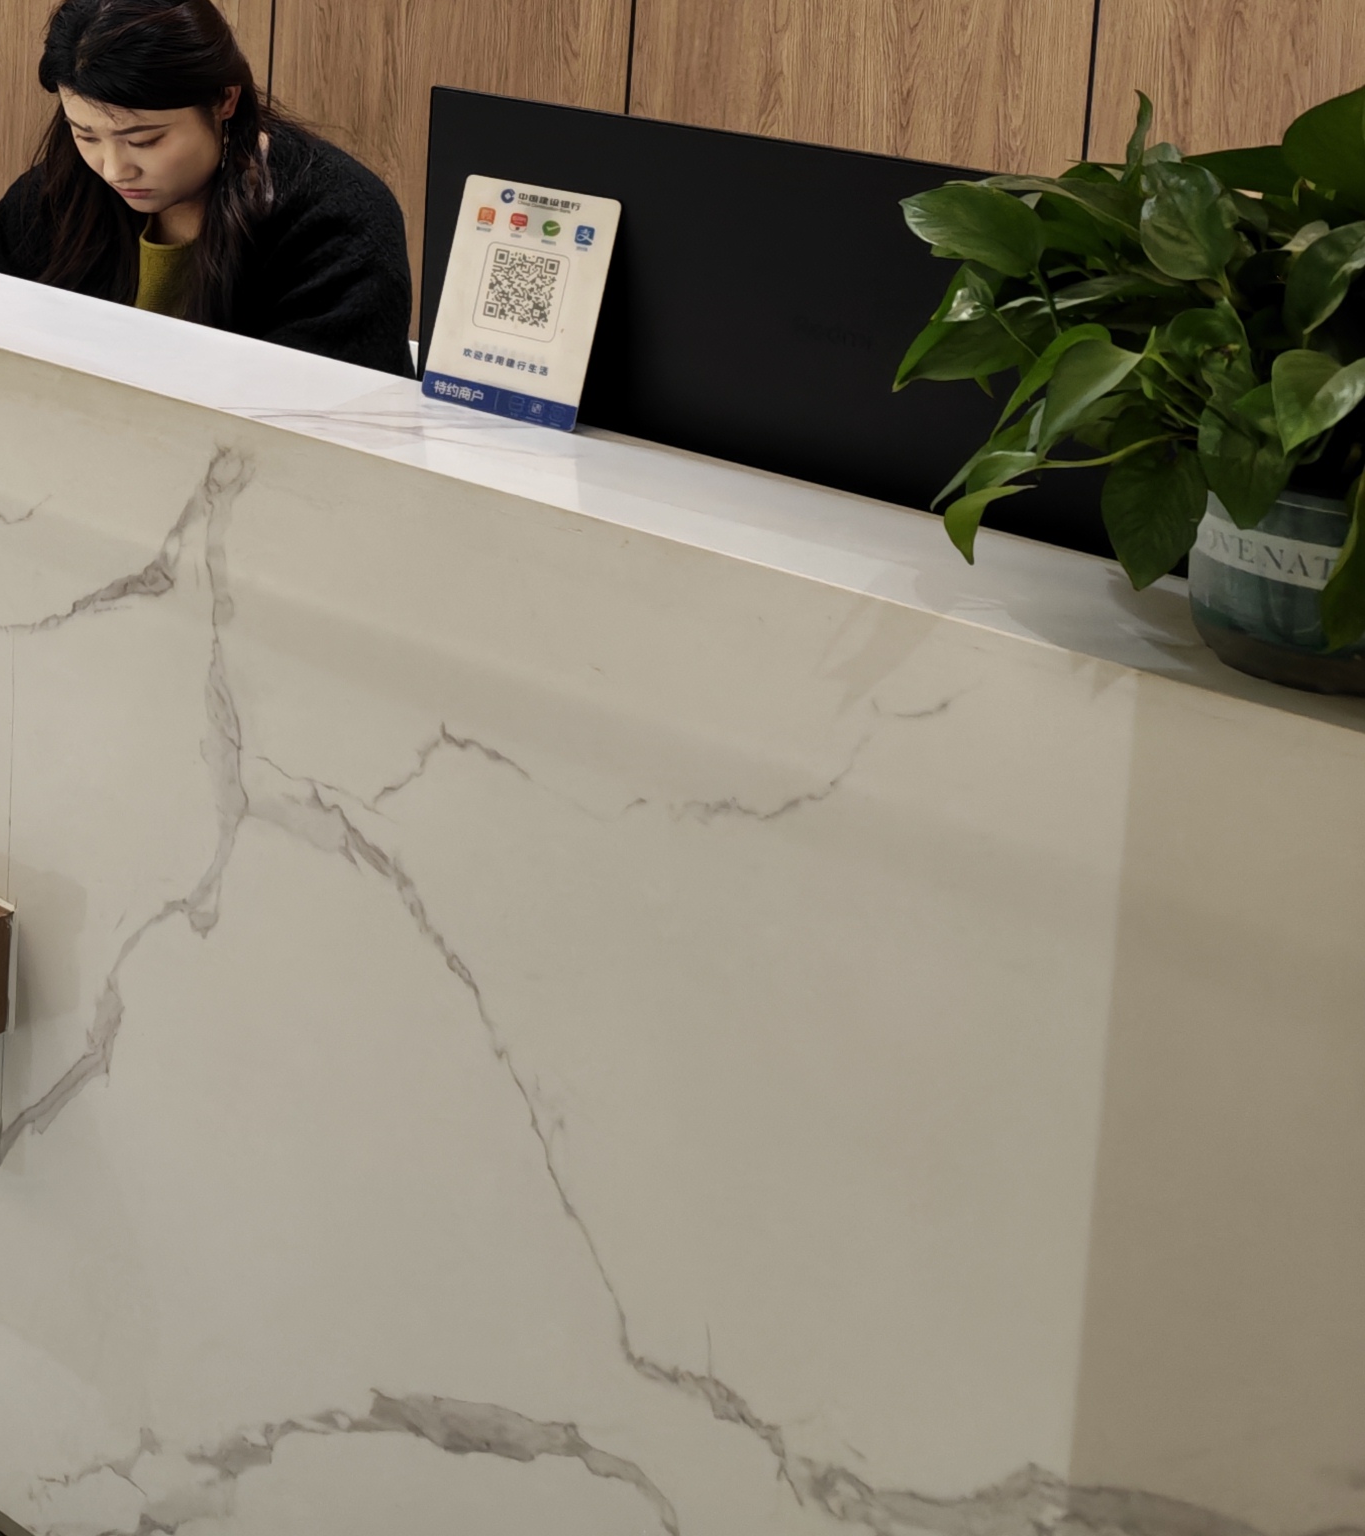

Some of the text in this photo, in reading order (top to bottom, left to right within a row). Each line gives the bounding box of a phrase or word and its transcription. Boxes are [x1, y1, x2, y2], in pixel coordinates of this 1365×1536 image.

[517, 192, 582, 212] 中国建设银行
[462, 347, 550, 377] 欢迎使用建行生活
[434, 379, 485, 403] 特约商户
